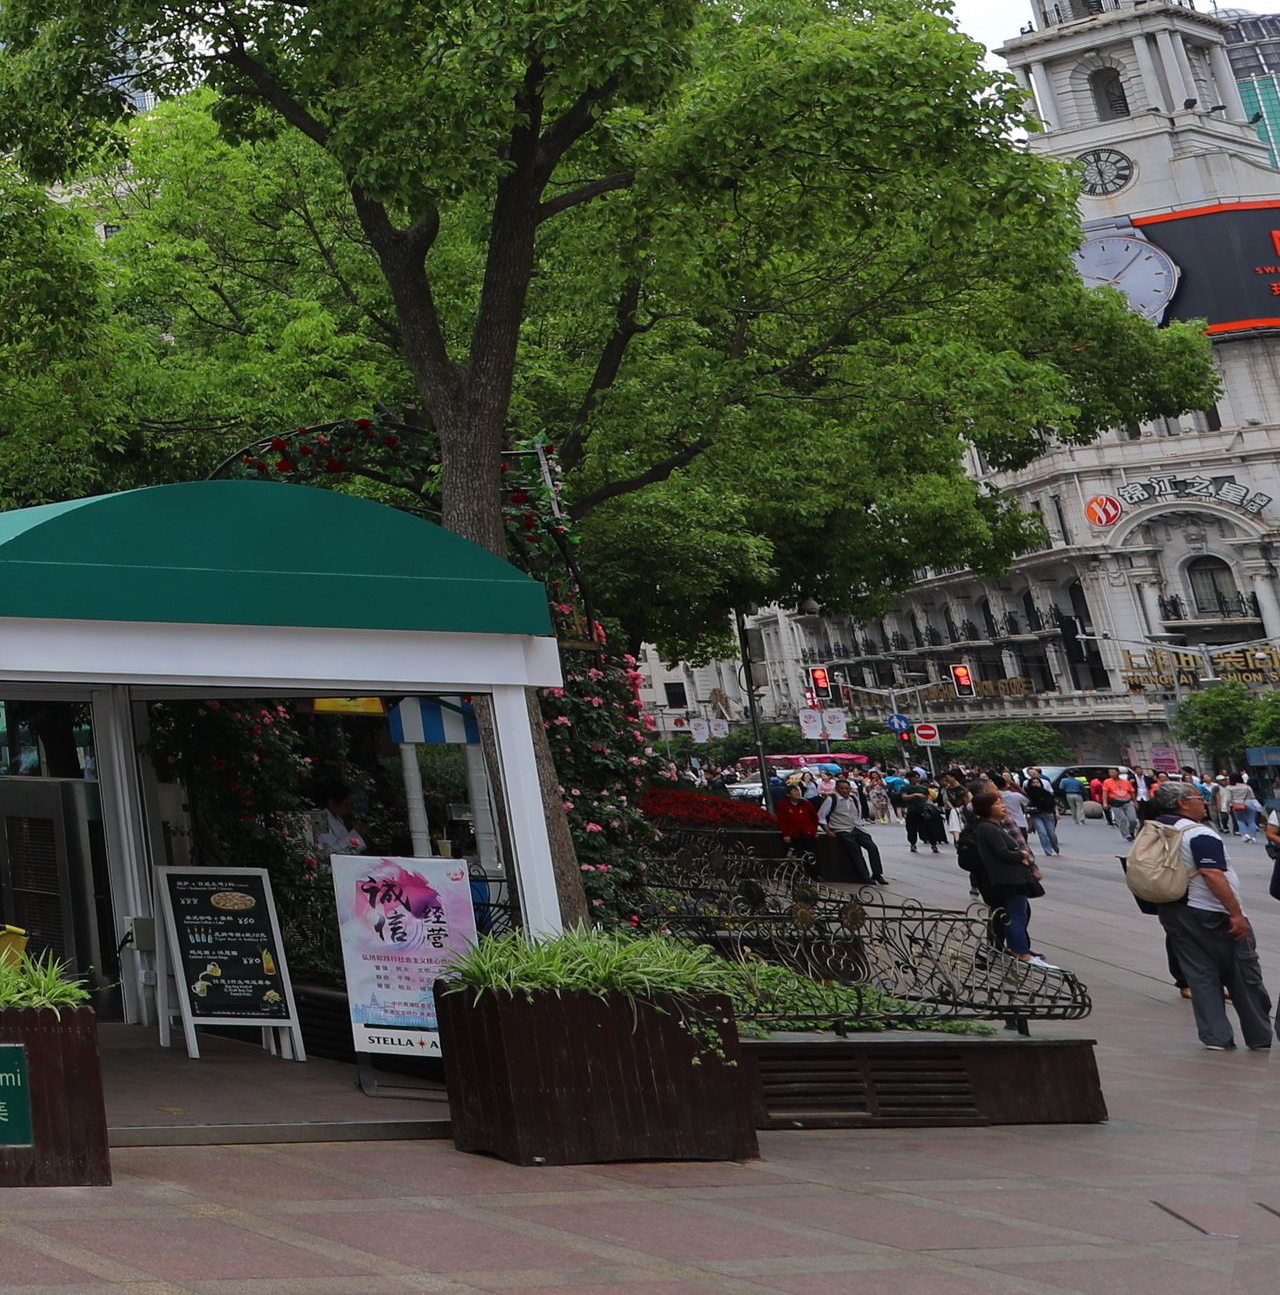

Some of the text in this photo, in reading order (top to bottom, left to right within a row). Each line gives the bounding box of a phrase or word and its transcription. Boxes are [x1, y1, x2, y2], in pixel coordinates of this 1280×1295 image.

[1117, 475, 1249, 506] 锦江之星
[1199, 672, 1263, 683] FSHION
[423, 906, 448, 948] 经营
[368, 1035, 414, 1047] STELLA
